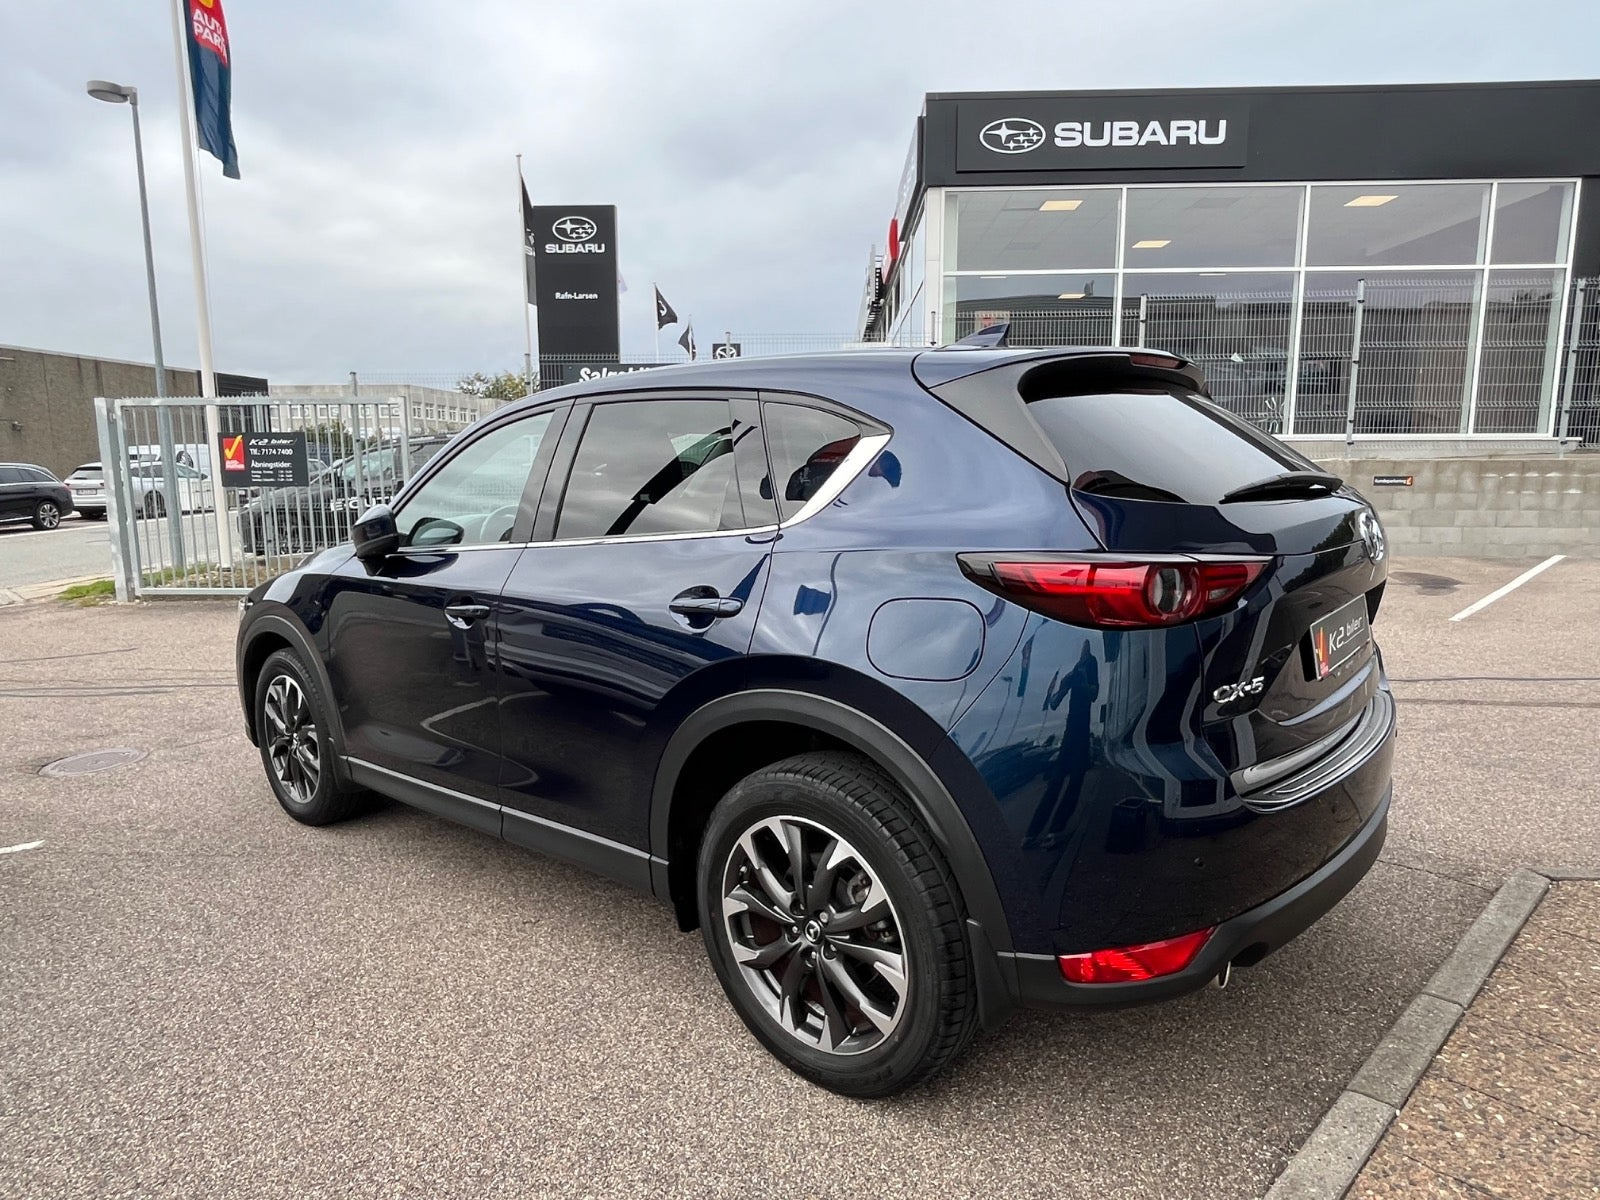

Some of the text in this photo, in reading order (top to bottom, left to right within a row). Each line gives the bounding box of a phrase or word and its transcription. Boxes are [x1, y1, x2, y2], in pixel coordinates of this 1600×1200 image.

[1054, 120, 1227, 147] SUBARU
[545, 243, 605, 253] SUBARU
[249, 438, 269, 446] K2
[250, 460, 293, 469] Åbningstider:
[1328, 626, 1344, 655] K2
[1213, 676, 1265, 703] CX-5
